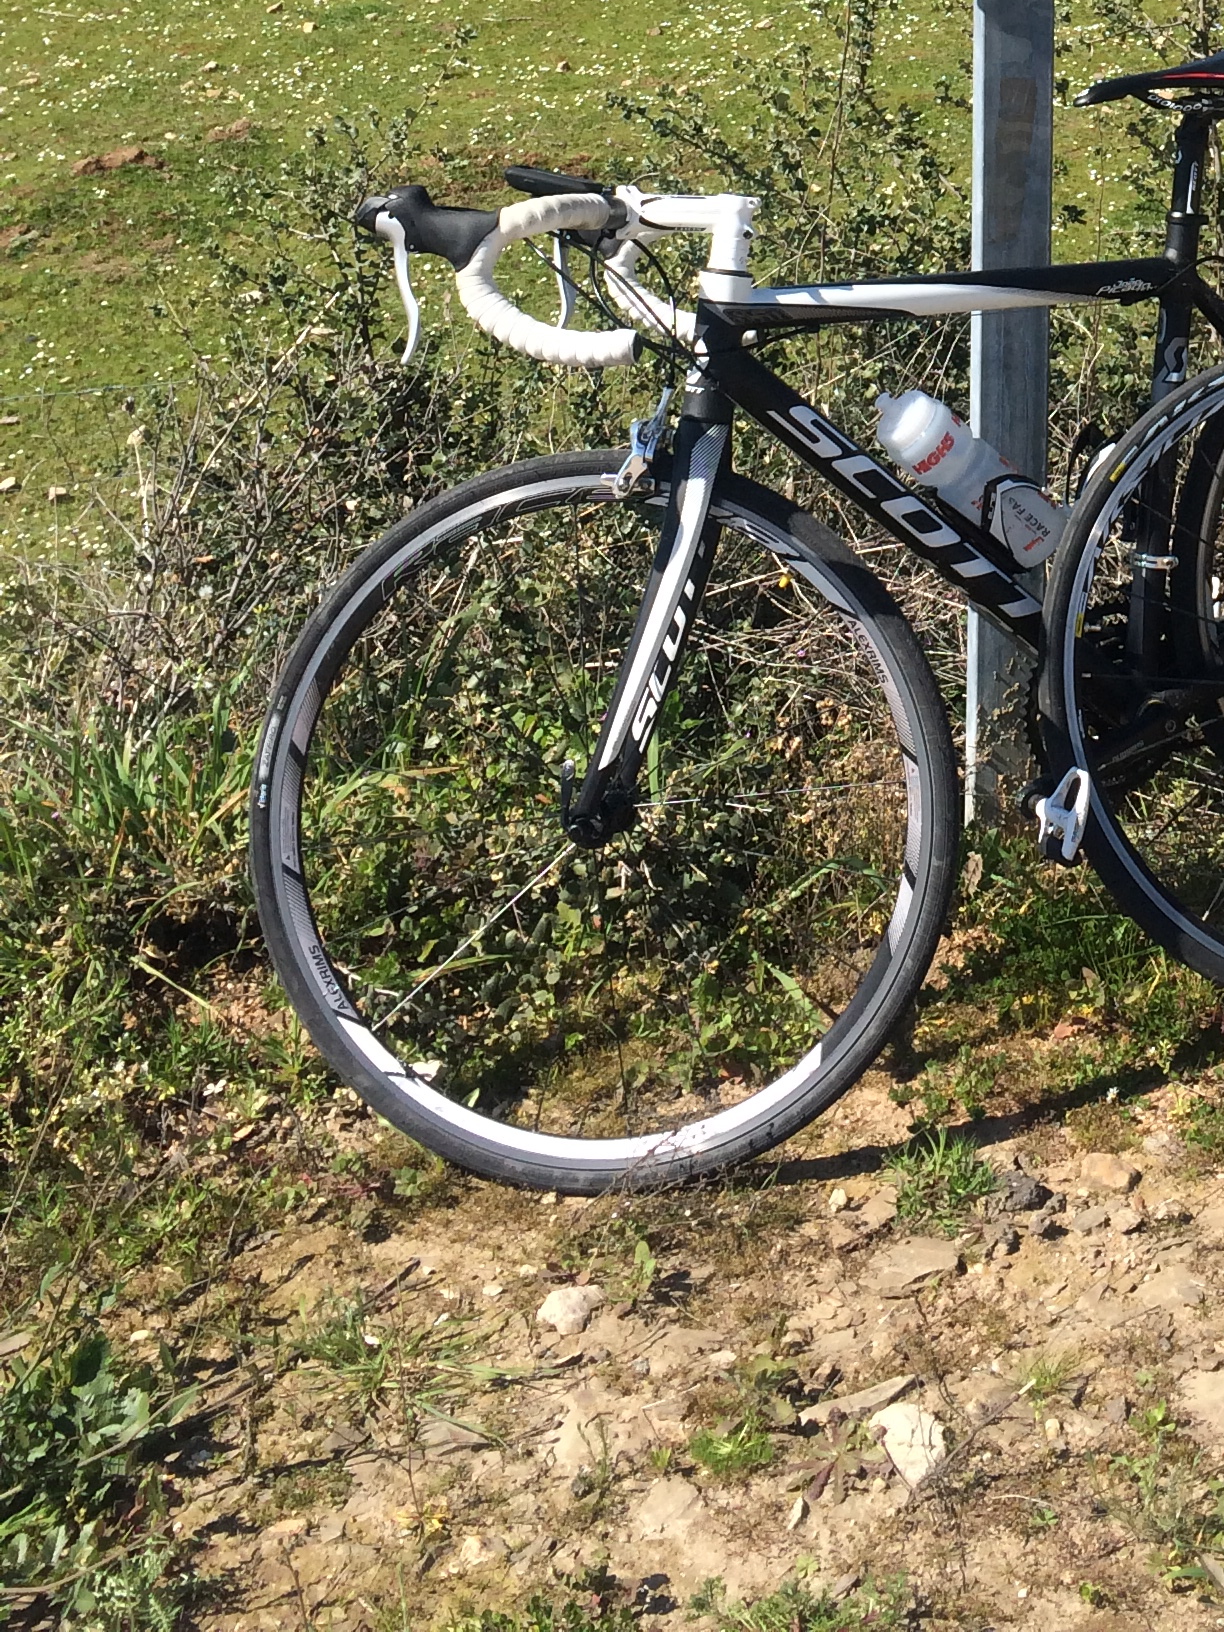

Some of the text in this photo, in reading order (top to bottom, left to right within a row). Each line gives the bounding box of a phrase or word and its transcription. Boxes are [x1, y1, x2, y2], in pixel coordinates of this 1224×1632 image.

[766, 404, 1044, 619] SCOTT
[1023, 513, 1051, 538] RACE
[847, 619, 889, 685] ALEXRIMS
[308, 944, 349, 1010] ALEXRIMS
